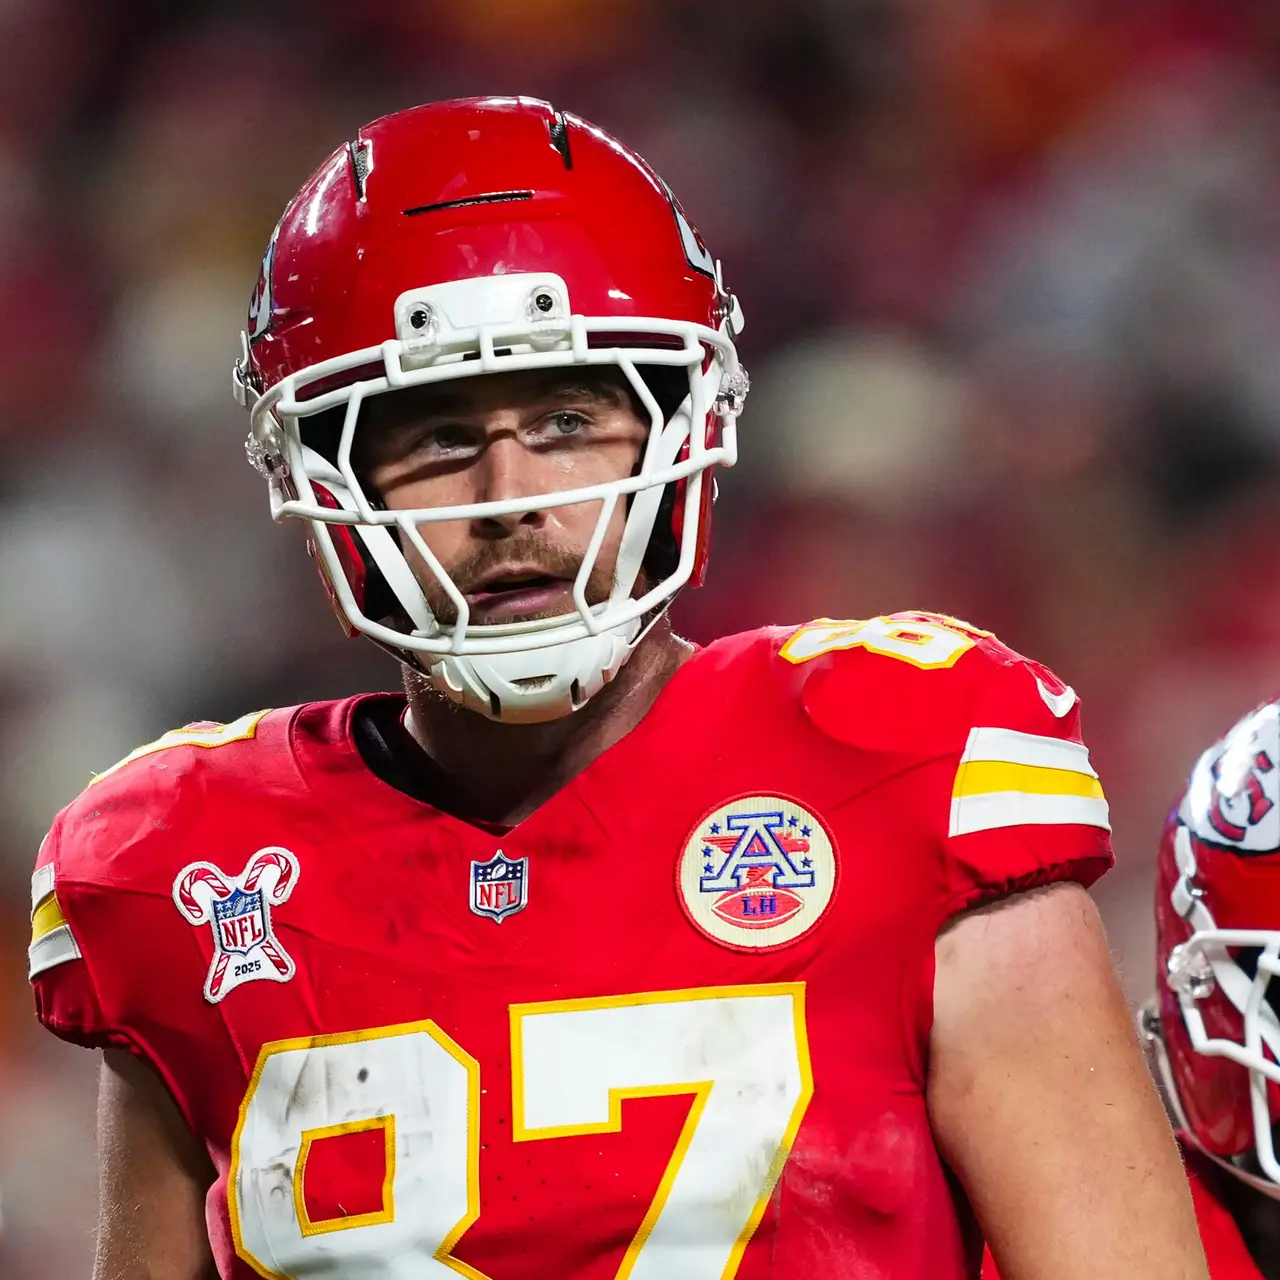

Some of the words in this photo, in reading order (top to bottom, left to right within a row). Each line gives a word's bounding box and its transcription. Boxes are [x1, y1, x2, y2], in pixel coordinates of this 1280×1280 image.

[700, 811, 815, 893] A
[478, 881, 519, 909] NFL
[741, 896, 776, 916] LH
[221, 914, 262, 947] NFL
[234, 959, 262, 977] 2025
